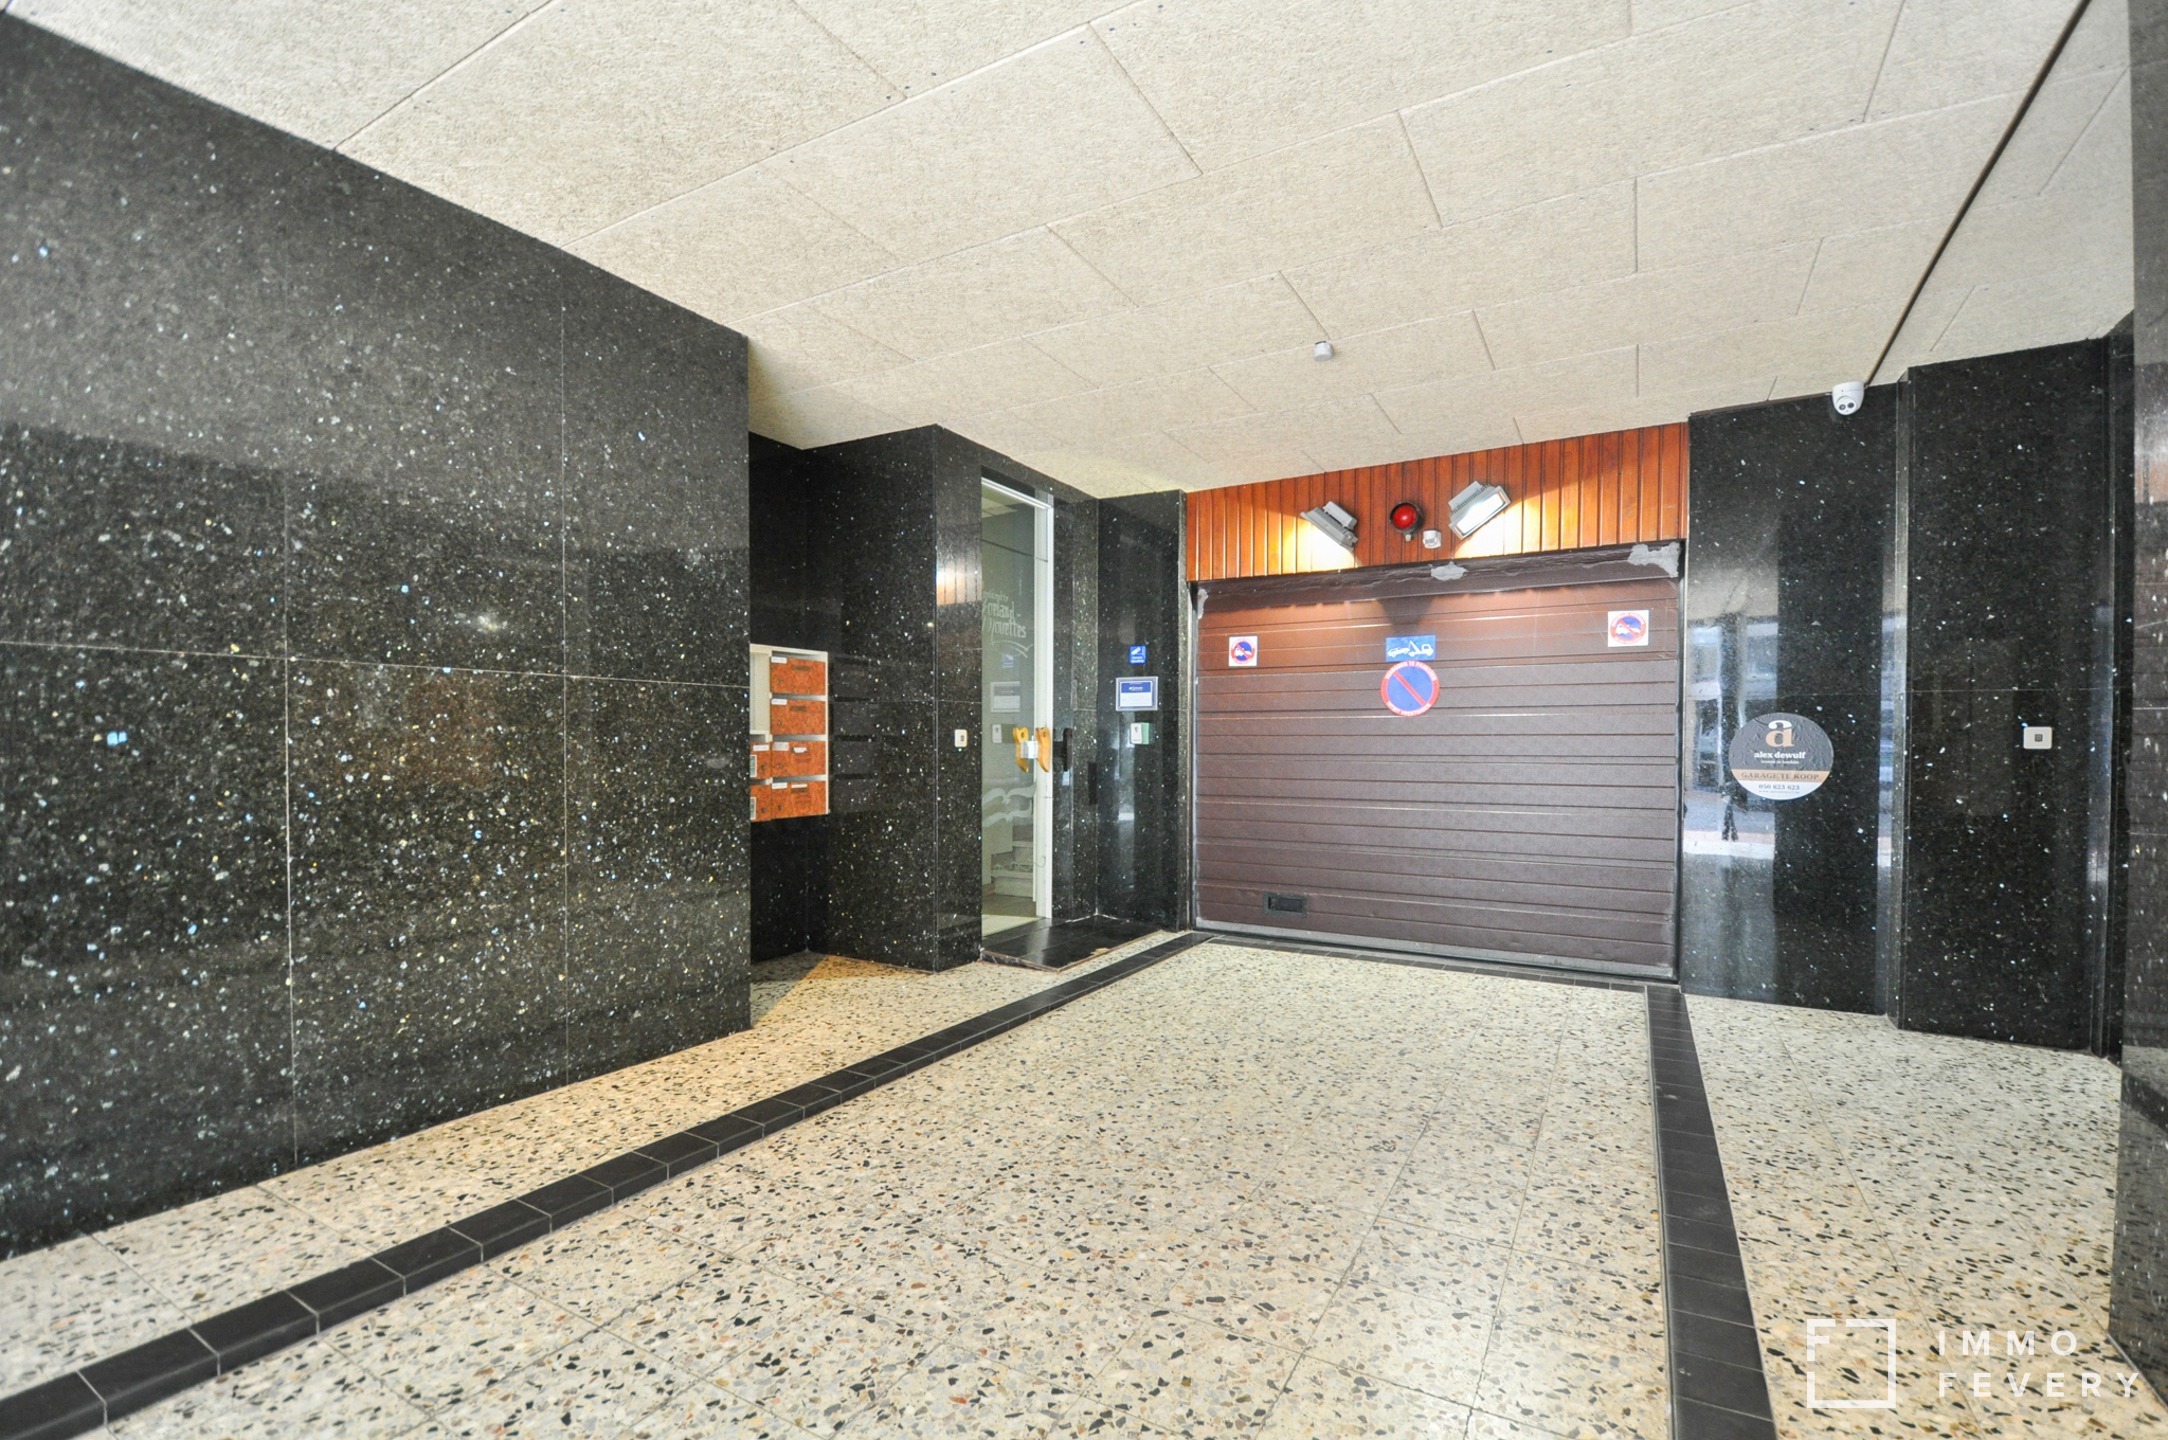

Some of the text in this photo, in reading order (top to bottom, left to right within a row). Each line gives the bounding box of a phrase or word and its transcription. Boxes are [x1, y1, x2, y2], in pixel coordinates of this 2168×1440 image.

[1765, 720, 1794, 748] a
[1754, 751, 1806, 759] alex dewulf
